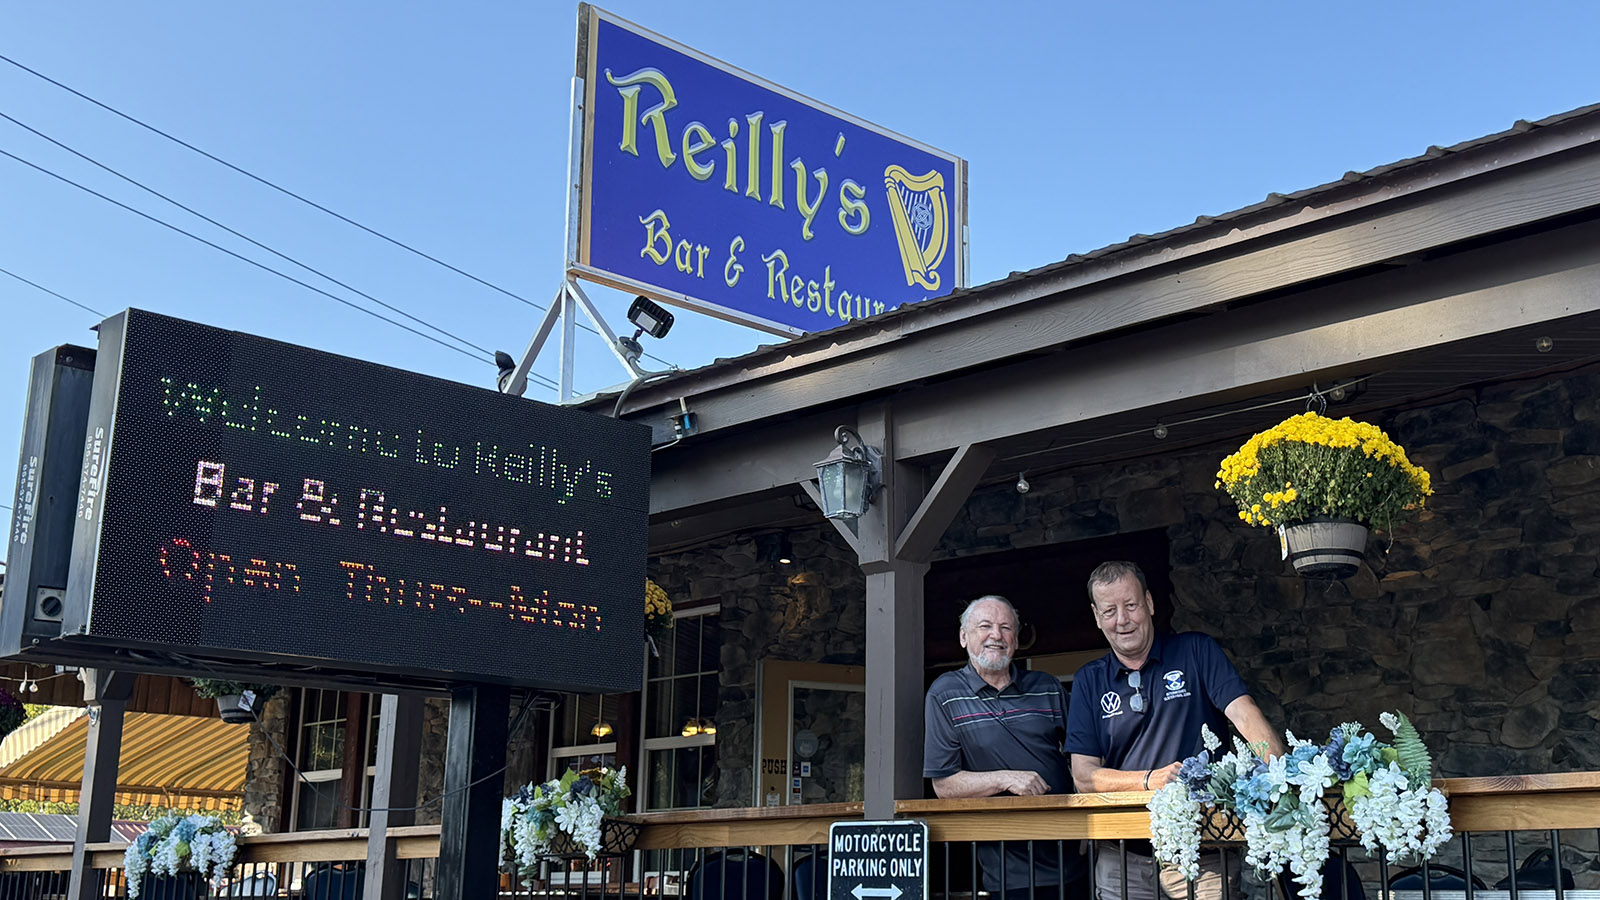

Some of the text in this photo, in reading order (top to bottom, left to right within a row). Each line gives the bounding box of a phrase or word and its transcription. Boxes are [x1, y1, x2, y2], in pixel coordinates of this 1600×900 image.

[603, 67, 871, 240] Reilly's
[639, 209, 710, 279] Bar
[724, 235, 746, 288] &
[20, 455, 38, 545] SureFire
[85, 426, 104, 520] SureFire
[193, 460, 279, 515] Bar
[762, 758, 787, 775] PUSH
[832, 858, 923, 878] PARKING ONLY
[834, 833, 921, 853] MOTORCYCLE
